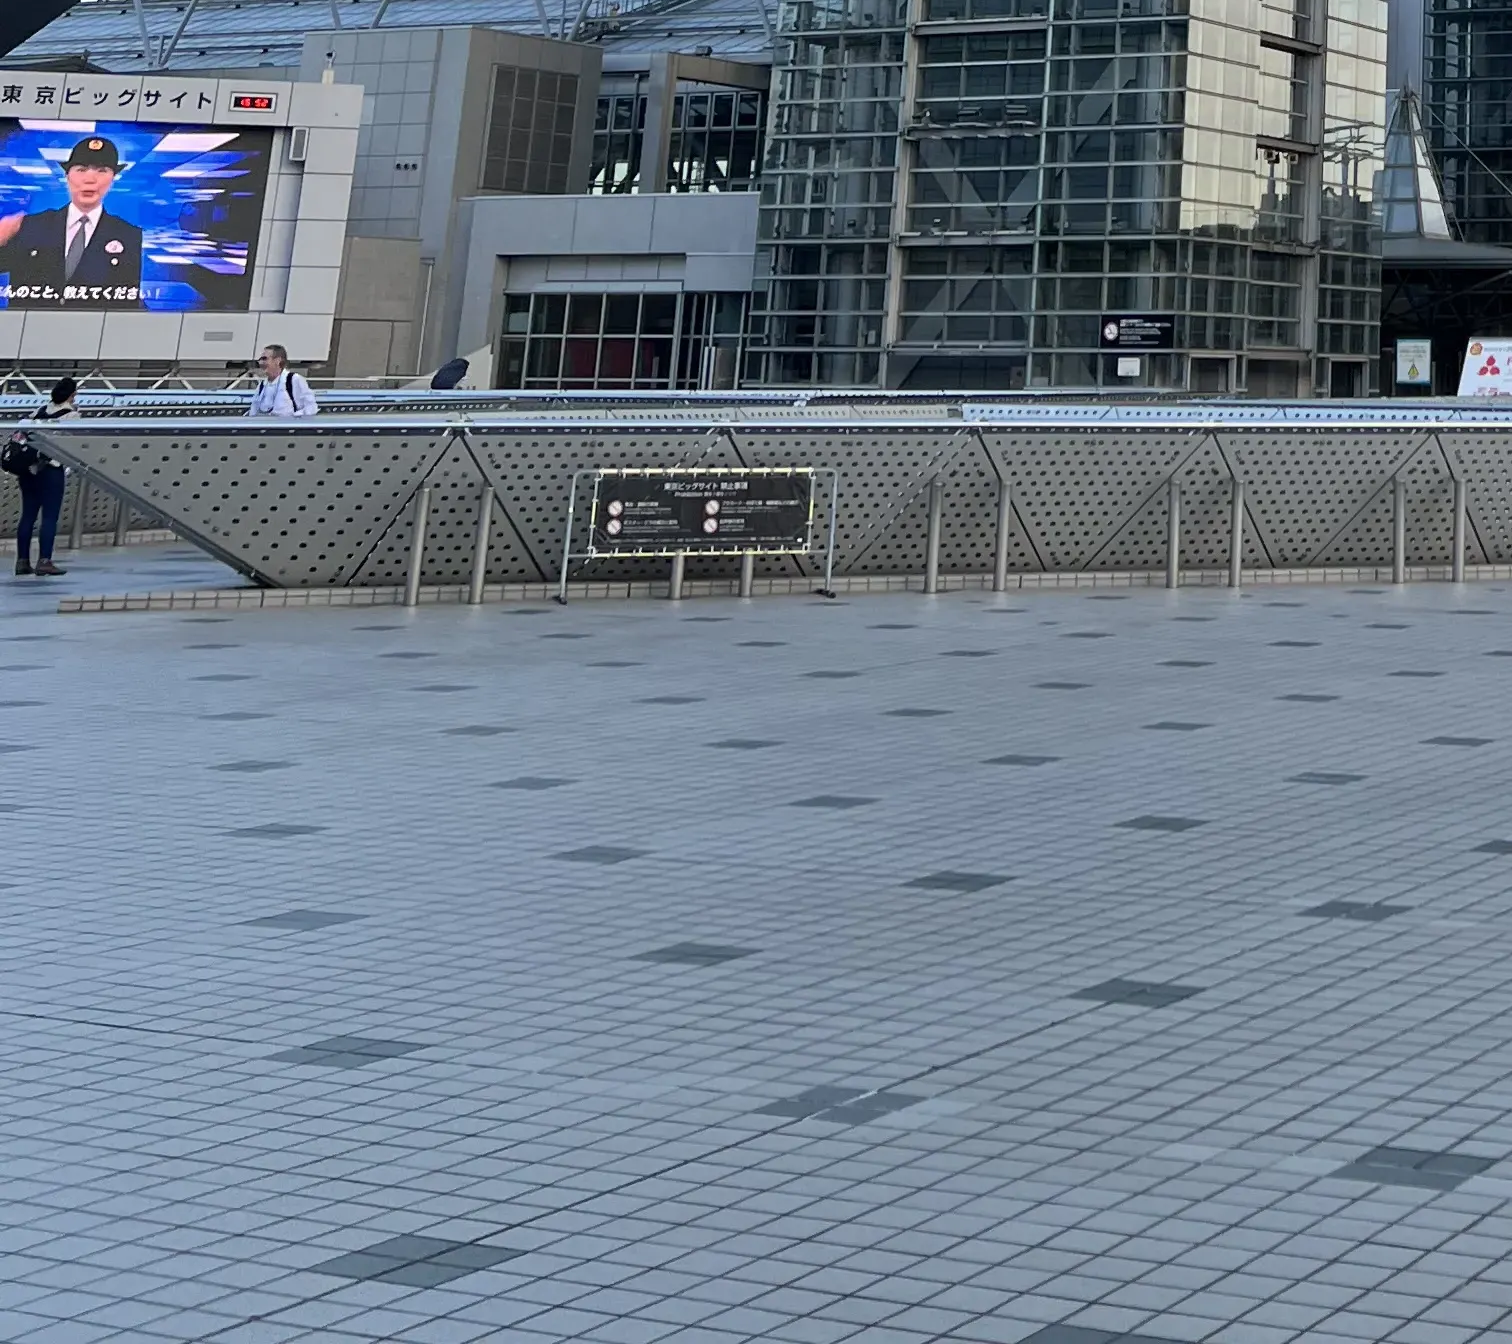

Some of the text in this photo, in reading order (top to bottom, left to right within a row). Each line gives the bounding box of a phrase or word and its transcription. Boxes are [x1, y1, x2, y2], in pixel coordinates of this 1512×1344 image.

[1, 83, 212, 110] 東京ビッグサイト
